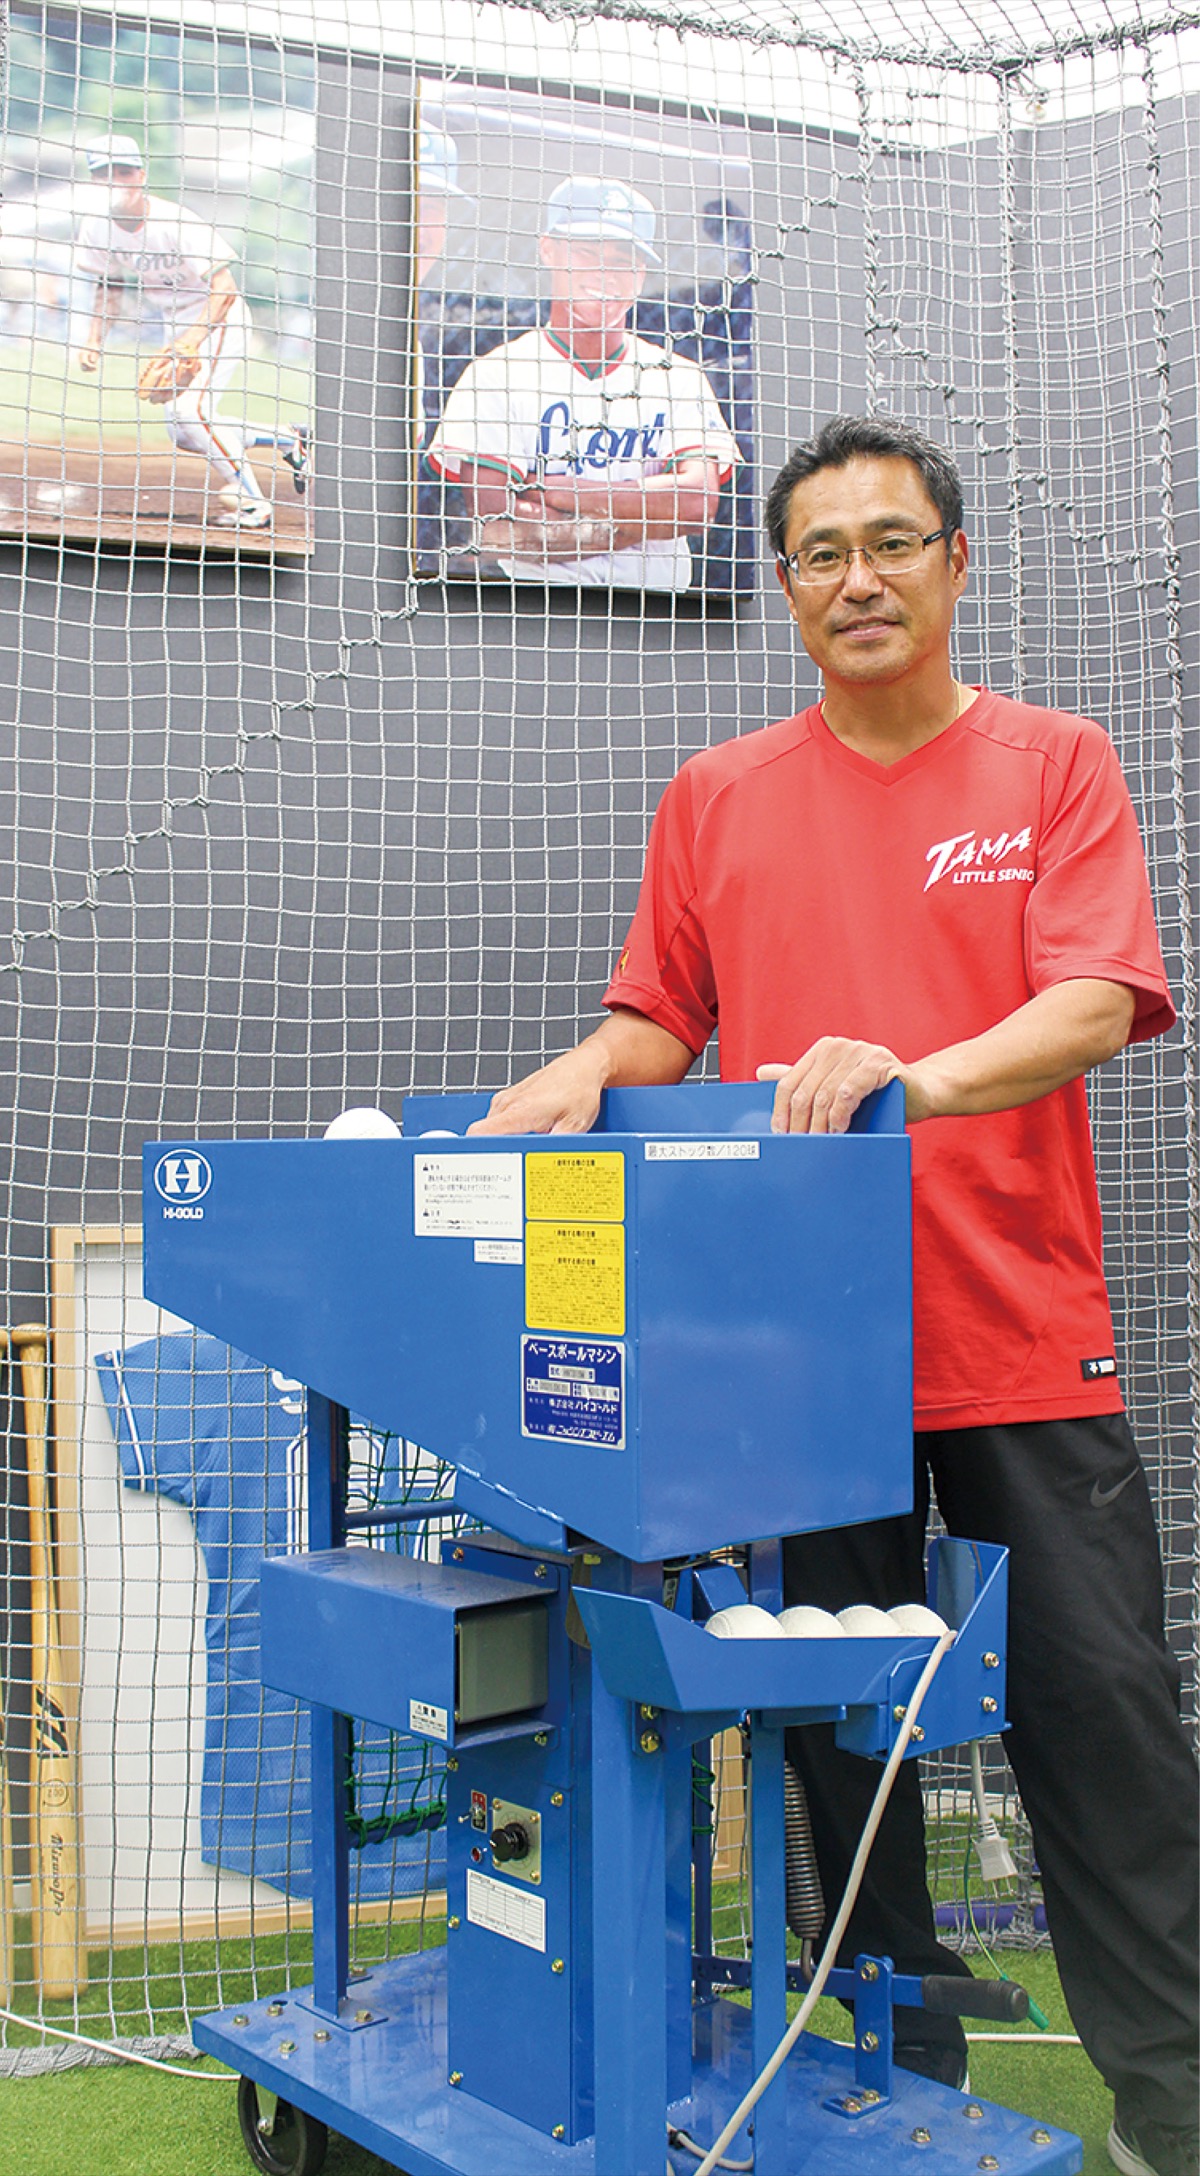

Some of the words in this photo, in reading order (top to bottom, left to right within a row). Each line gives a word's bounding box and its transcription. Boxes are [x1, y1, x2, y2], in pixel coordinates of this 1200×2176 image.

[923, 826, 1032, 893] TAMA
[952, 870, 996, 884] LITTLE
[163, 1207, 204, 1219] HI-GOLD
[528, 1342, 617, 1364] ベースボールマシン
